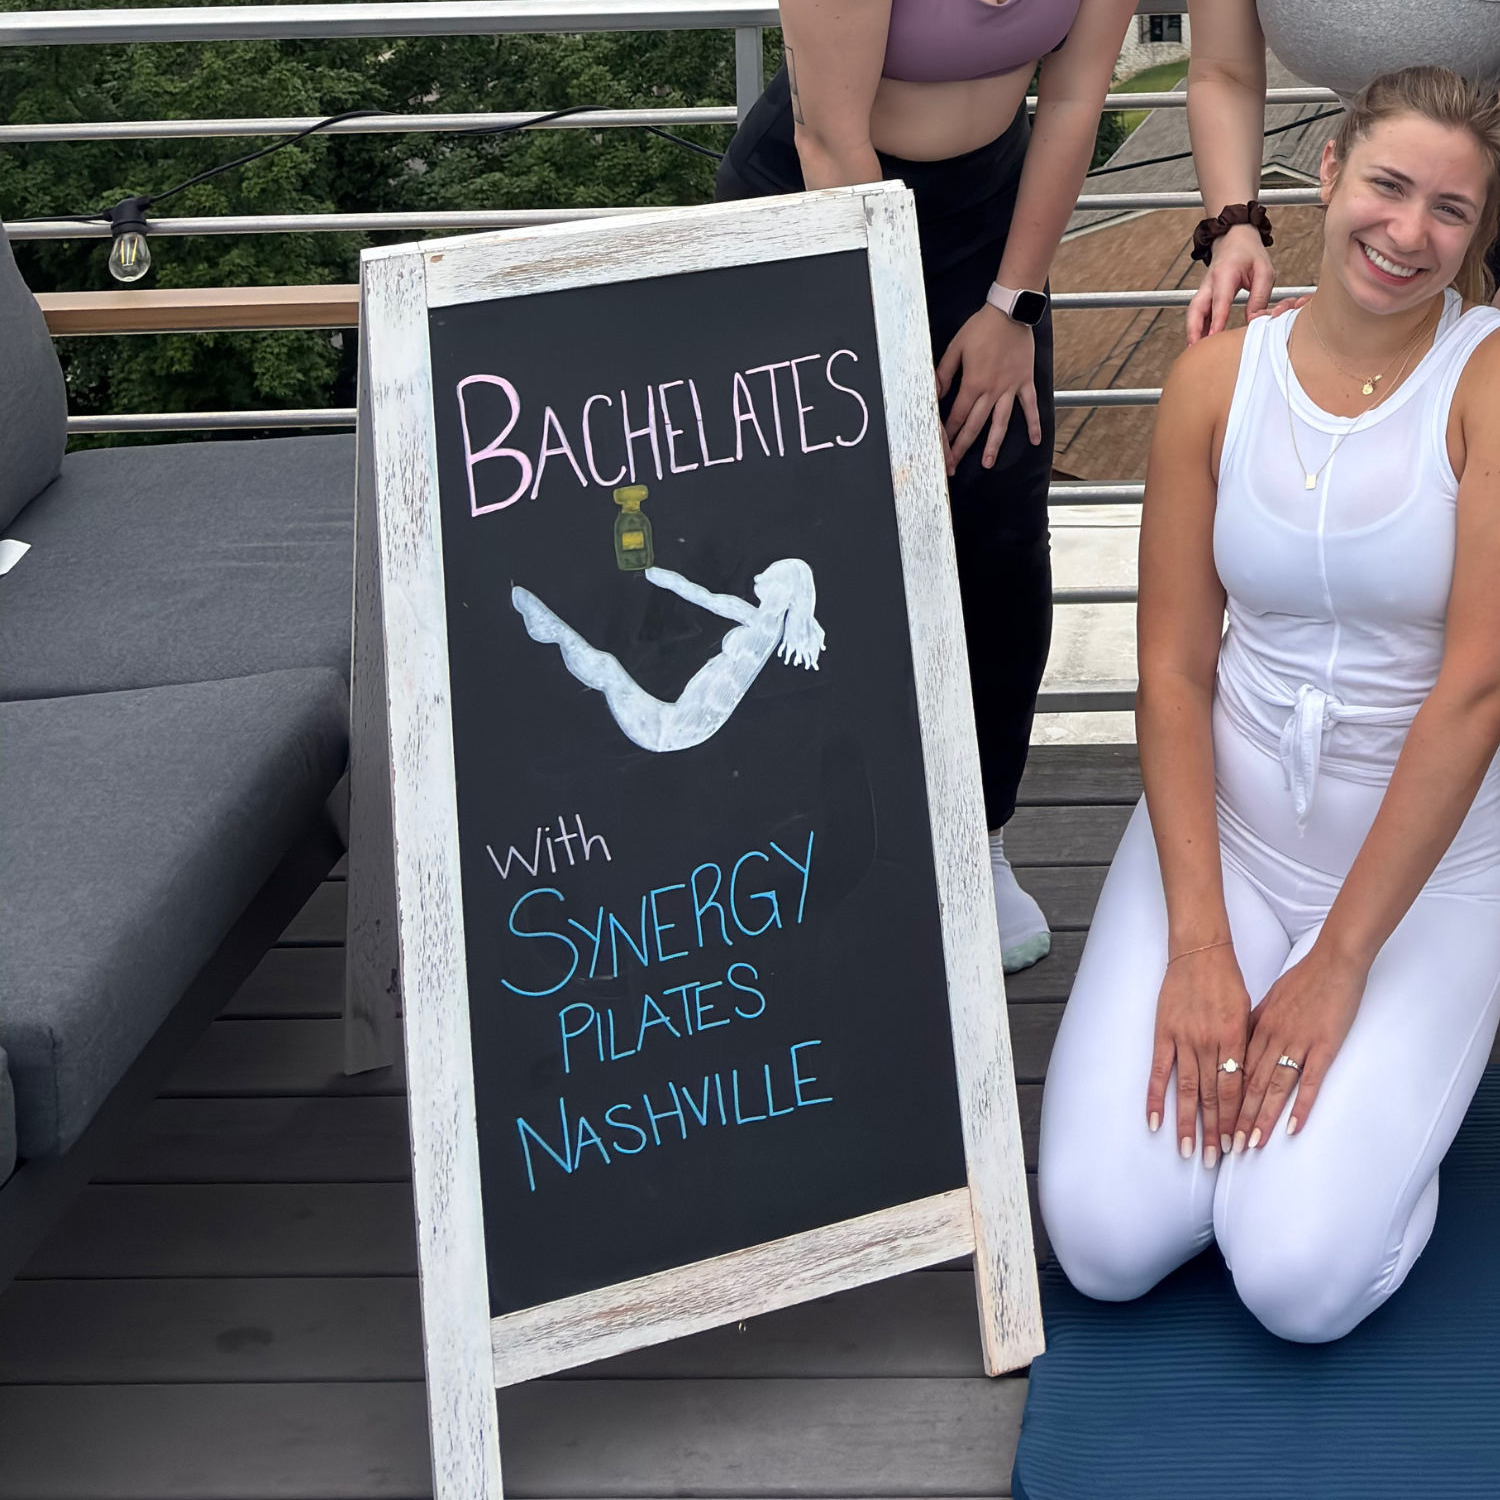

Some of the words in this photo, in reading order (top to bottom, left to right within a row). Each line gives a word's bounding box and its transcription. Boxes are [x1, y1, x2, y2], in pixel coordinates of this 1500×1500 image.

[456, 349, 869, 518] BACHELATES
[501, 830, 815, 997] SYNERGY
[558, 962, 766, 1074] PILATES
[516, 1040, 833, 1192] NASHVILLE
